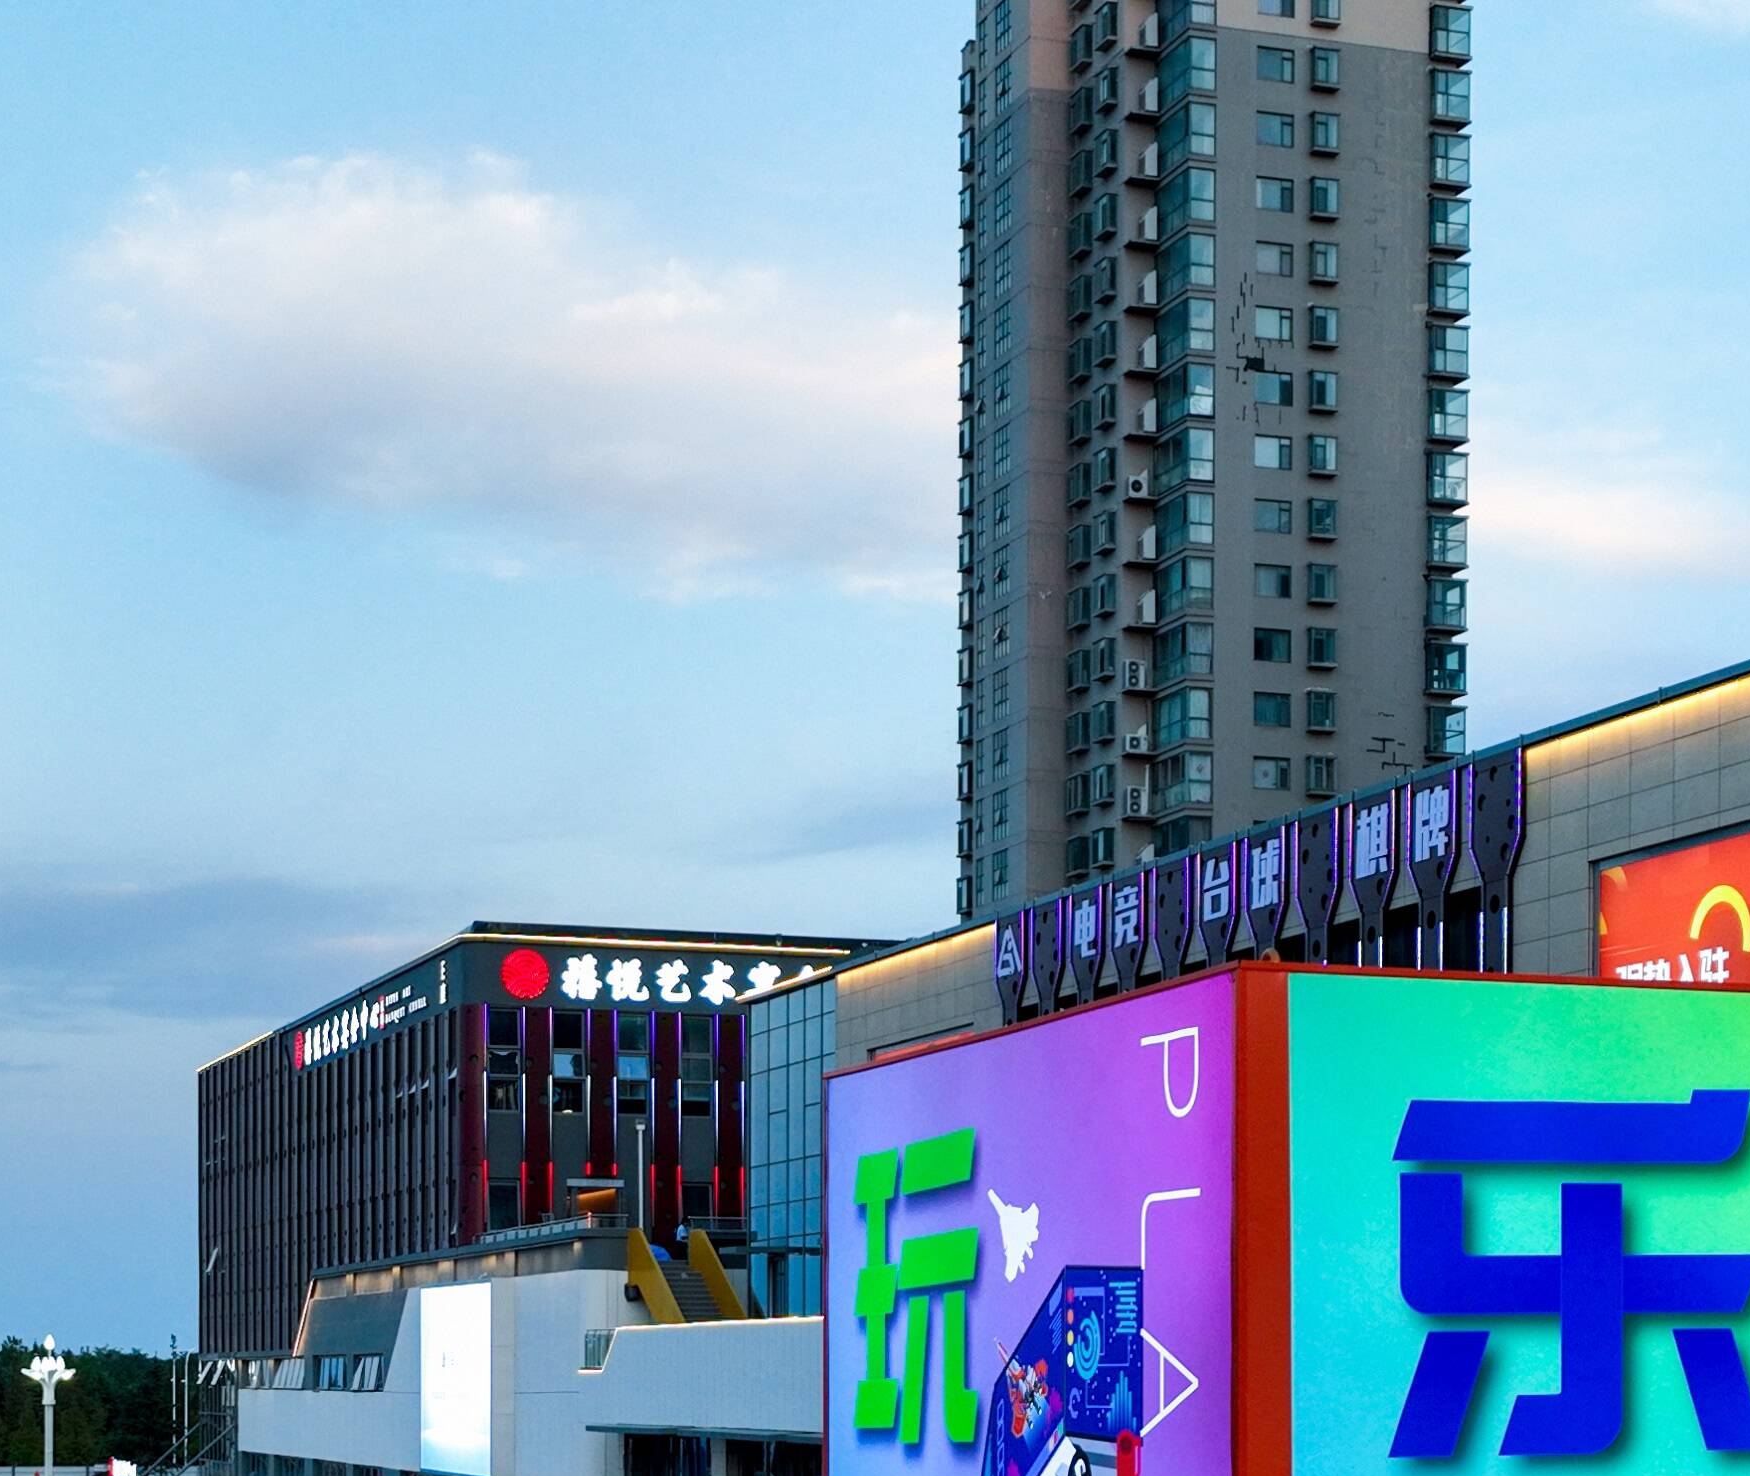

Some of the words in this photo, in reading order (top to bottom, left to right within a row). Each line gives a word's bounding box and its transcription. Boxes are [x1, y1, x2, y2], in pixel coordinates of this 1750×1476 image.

[1074, 884, 1140, 958] 电竞
[1203, 840, 1282, 921] 台球
[1355, 783, 1450, 879] 棋牌
[854, 1127, 980, 1444] 玩
